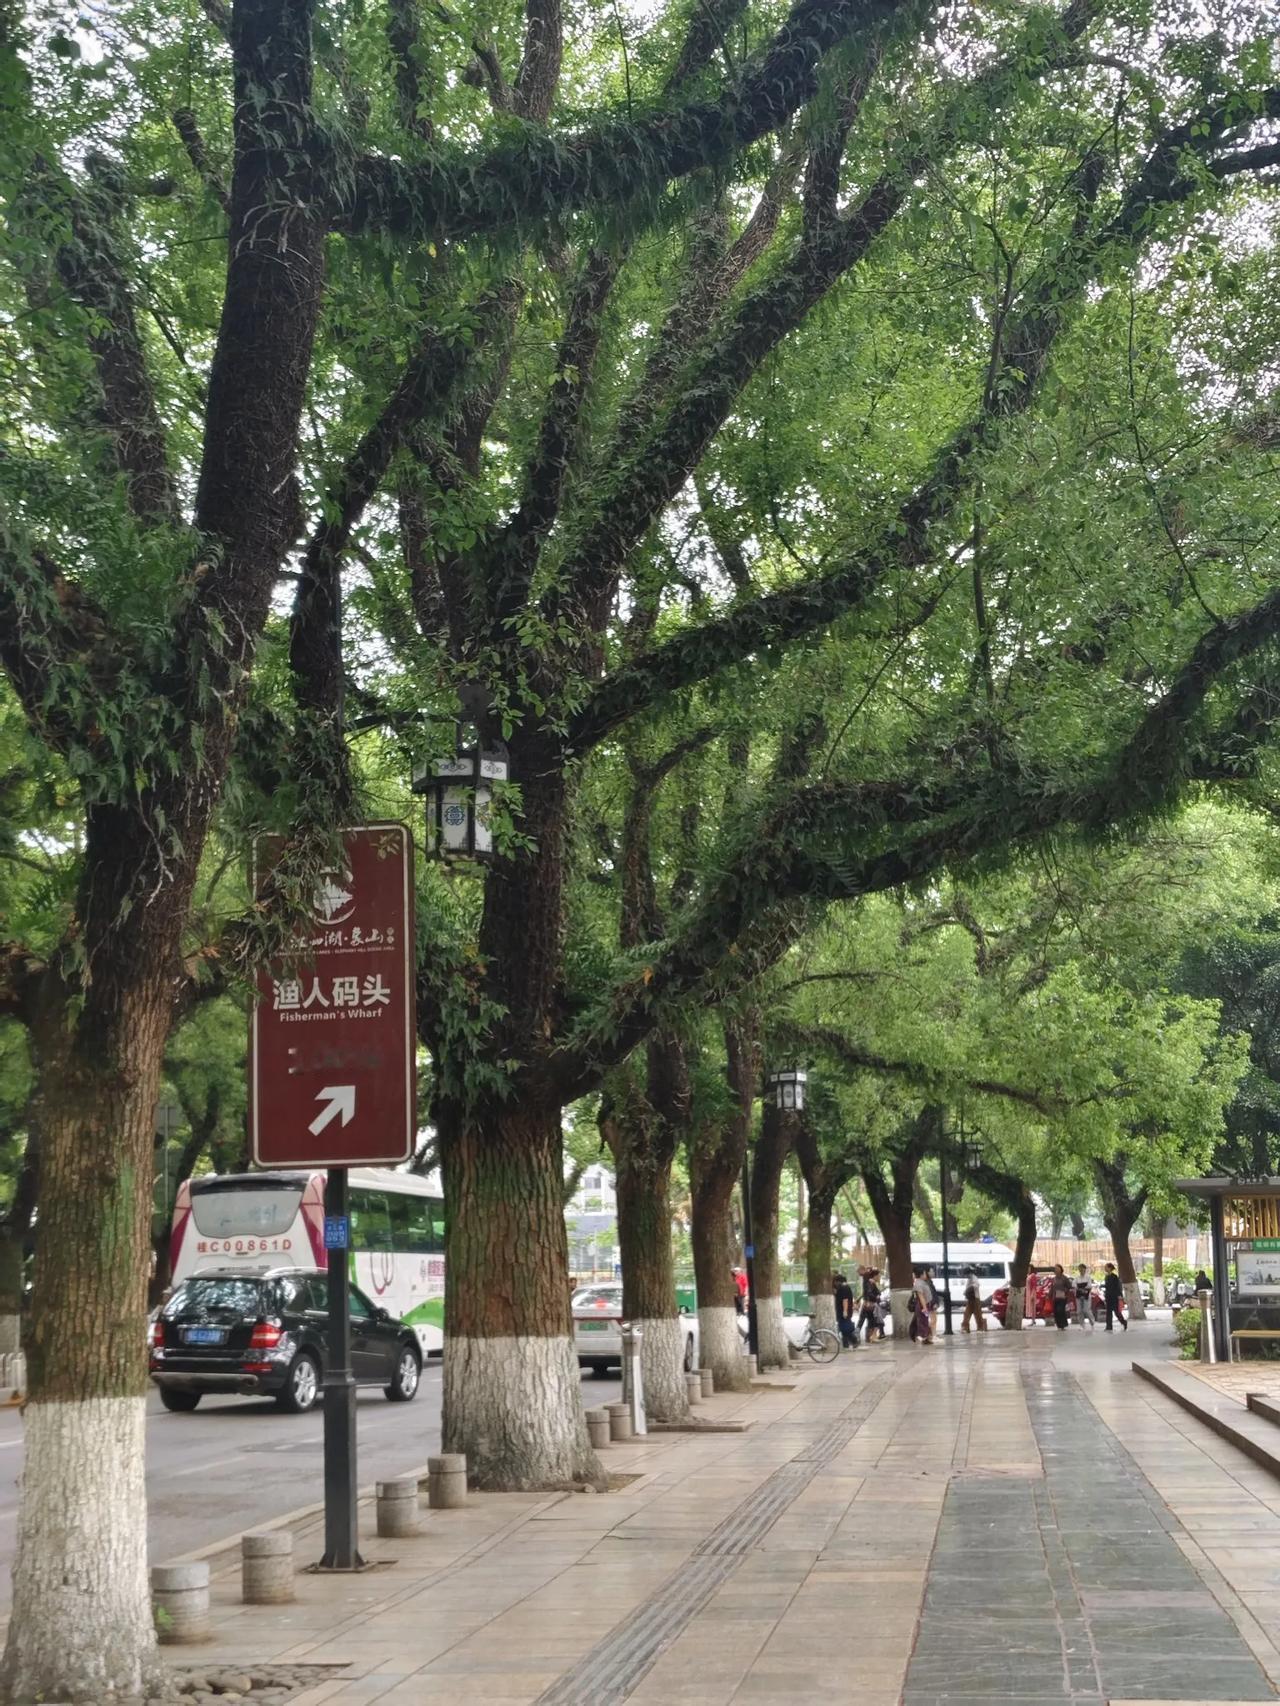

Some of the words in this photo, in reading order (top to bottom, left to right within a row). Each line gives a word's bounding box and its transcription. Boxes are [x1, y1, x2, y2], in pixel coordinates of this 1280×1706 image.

[273, 974, 391, 1010] 渔人码头
[280, 1010, 345, 1022] Fisherman's
[348, 1008, 382, 1019] Wharf
